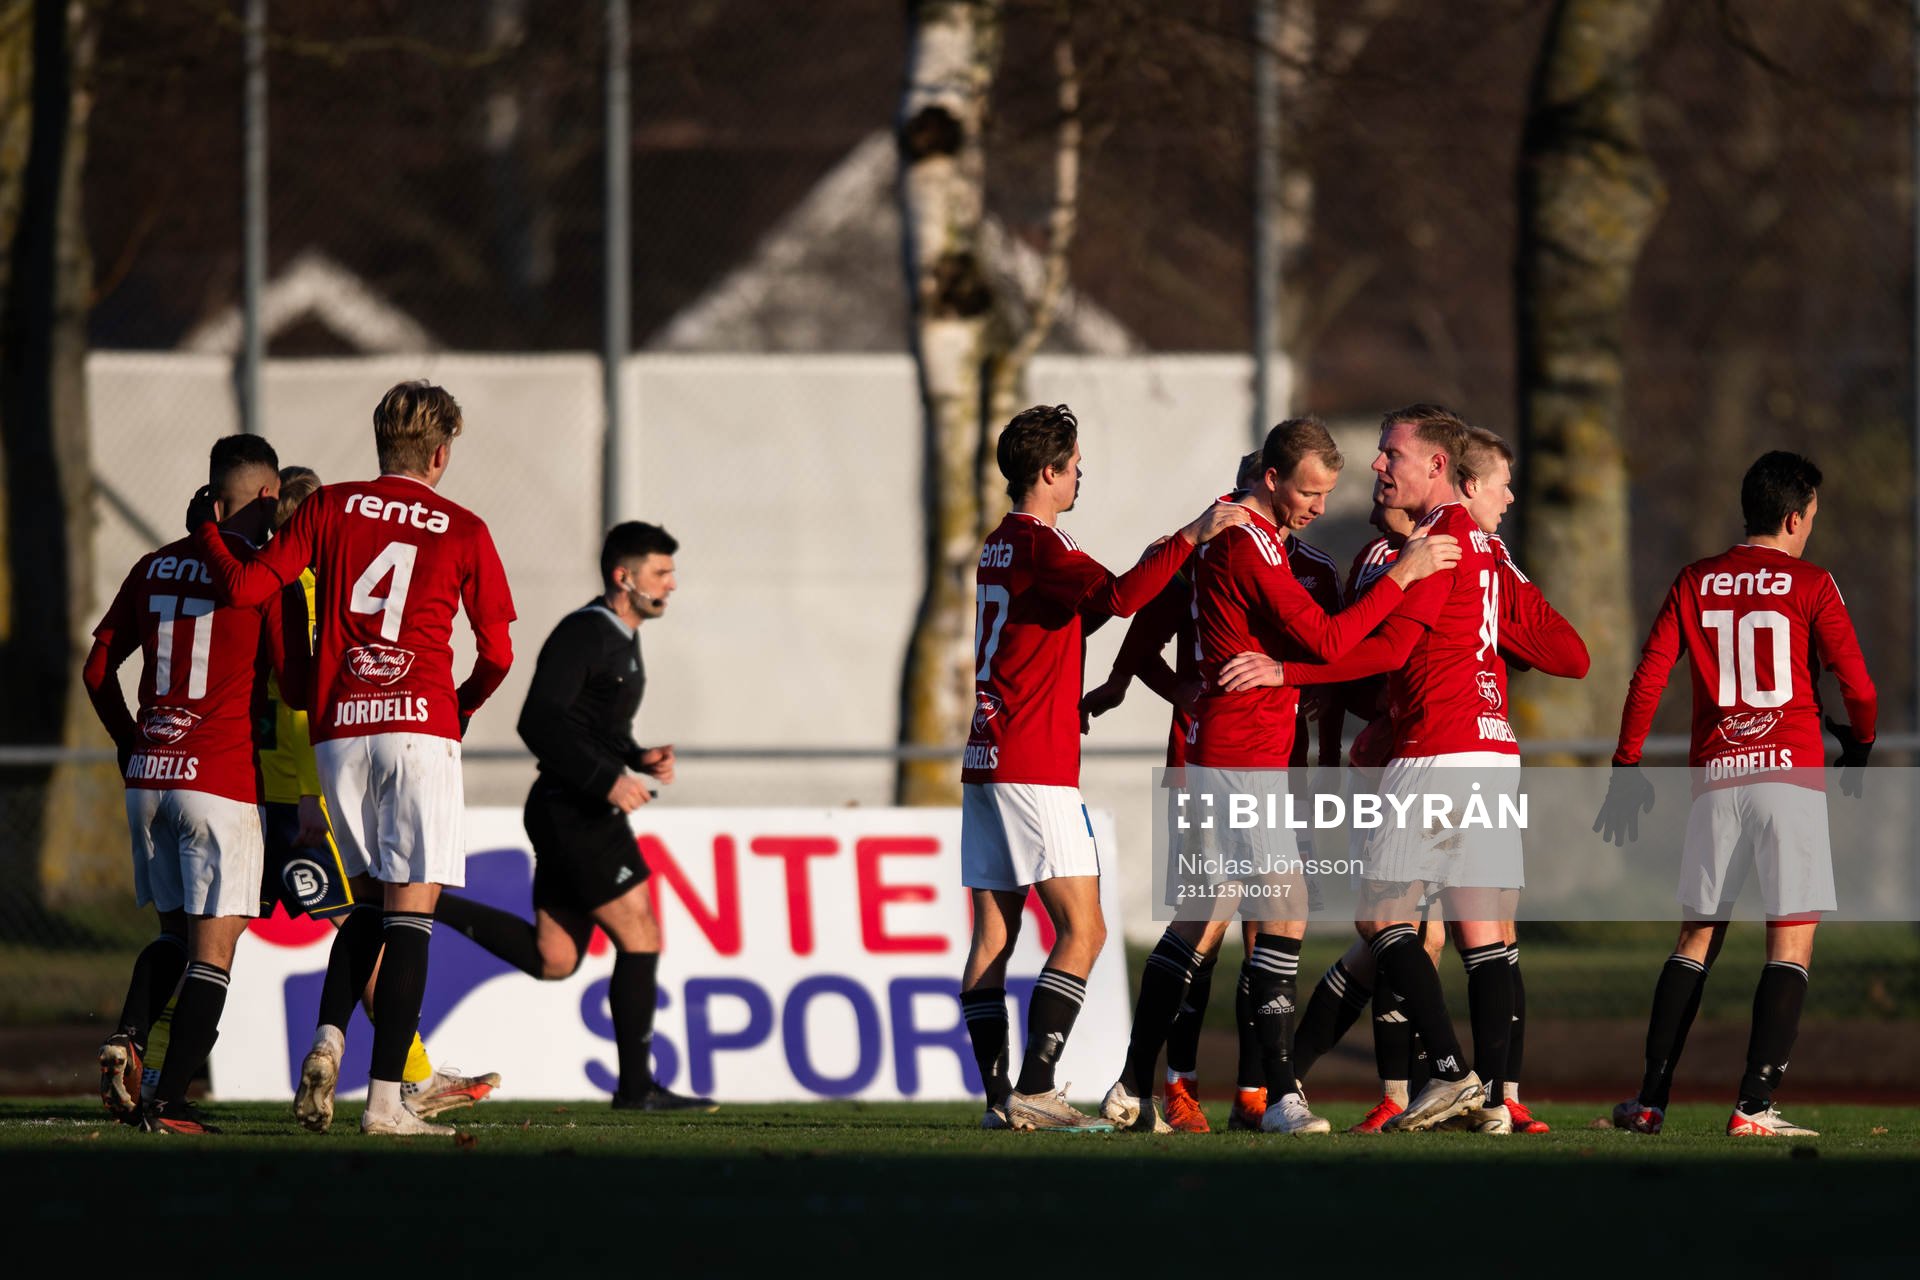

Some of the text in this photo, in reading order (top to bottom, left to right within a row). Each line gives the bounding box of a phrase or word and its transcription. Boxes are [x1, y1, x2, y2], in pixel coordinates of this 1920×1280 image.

[345, 494, 450, 534] renta
[980, 539, 1013, 568] enta
[146, 556, 212, 584] rent
[1700, 568, 1792, 596] renta
[350, 541, 418, 643] 4
[149, 595, 215, 700] 11
[1702, 610, 1793, 708] 10
[334, 697, 429, 727] JORDELLS
[1477, 716, 1517, 743] JORDELL
[963, 745, 999, 769] RDELLS
[1704, 748, 1793, 783] JORDELLS
[1257, 1005, 1295, 1015] adidas
